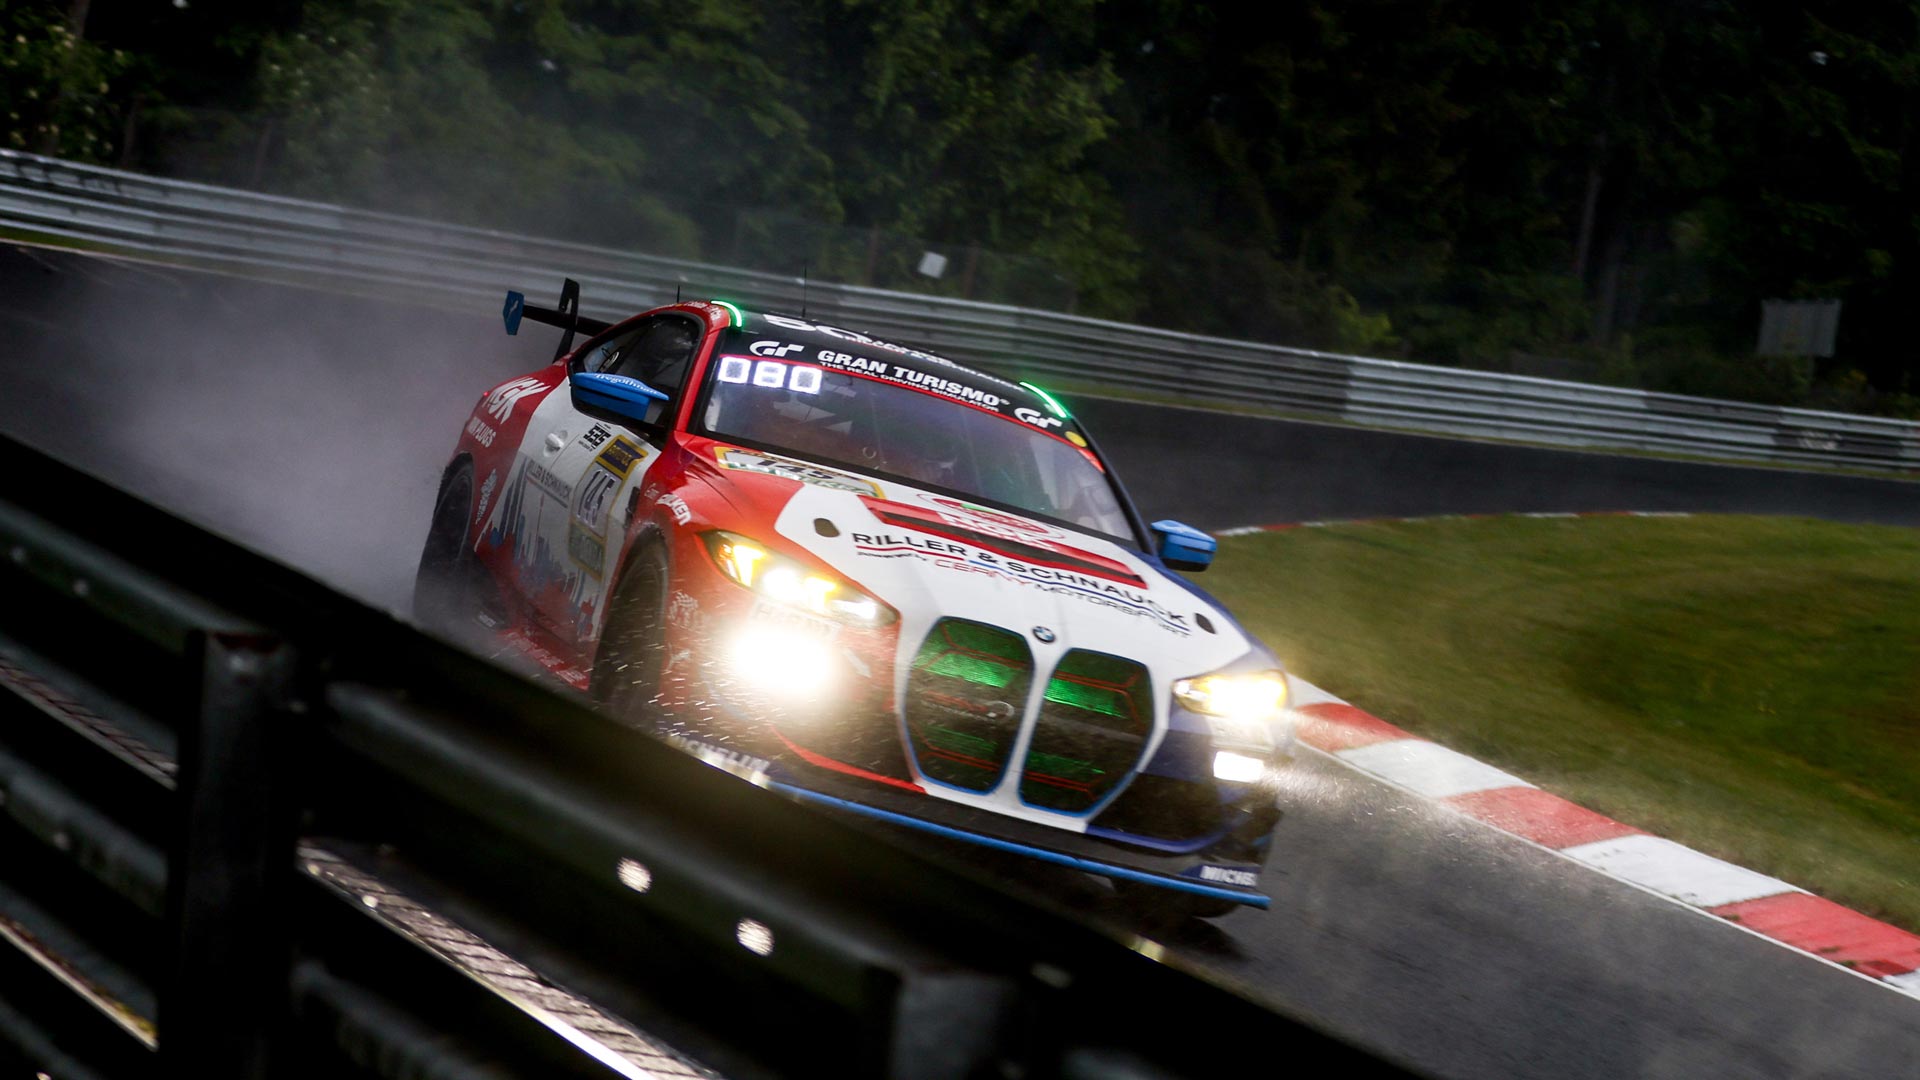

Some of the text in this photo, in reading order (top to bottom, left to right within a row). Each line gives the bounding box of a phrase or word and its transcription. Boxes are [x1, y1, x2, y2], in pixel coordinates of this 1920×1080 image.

[718, 356, 822, 395] 080
[817, 350, 887, 374] GRAN
[893, 366, 1001, 406] TURISMO
[820, 361, 843, 370] THE
[846, 367, 880, 378] REAL
[880, 374, 929, 391] DRIVING
[757, 459, 834, 481] 145
[852, 533, 1188, 626] RILLER & SCHNAUCK
